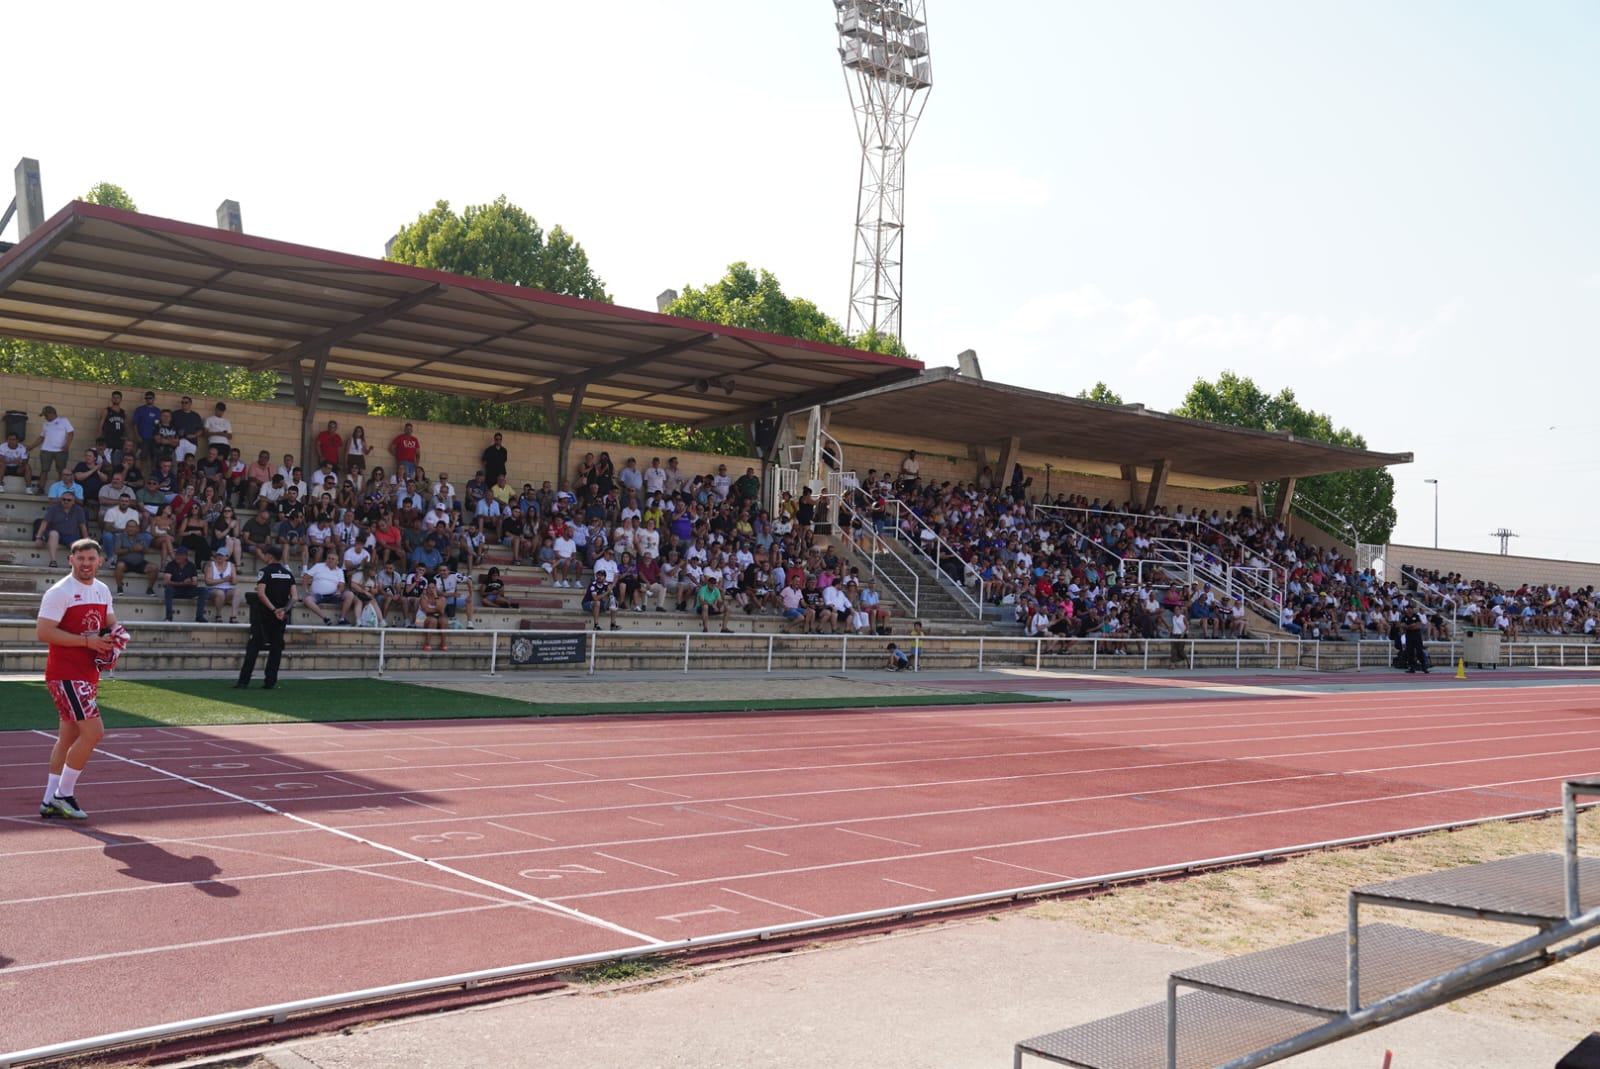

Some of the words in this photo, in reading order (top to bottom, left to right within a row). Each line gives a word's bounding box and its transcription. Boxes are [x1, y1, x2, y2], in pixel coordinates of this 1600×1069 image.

[409, 831, 485, 843] 3
[518, 864, 607, 880] 2
[654, 904, 740, 923] 1
